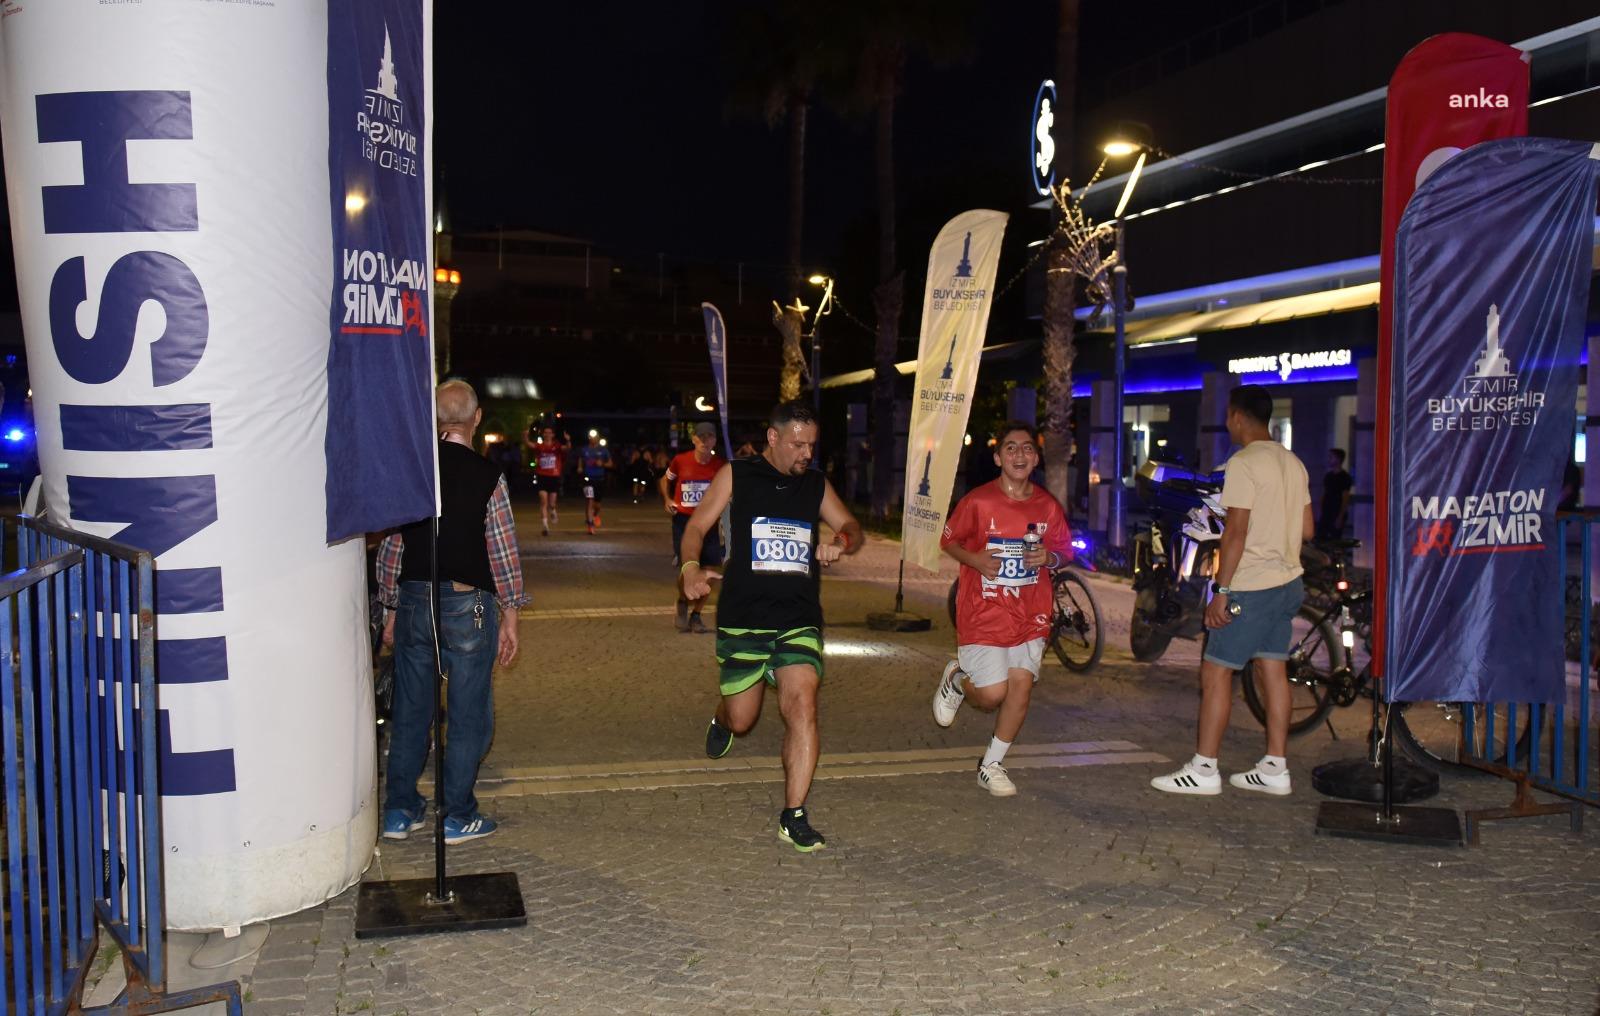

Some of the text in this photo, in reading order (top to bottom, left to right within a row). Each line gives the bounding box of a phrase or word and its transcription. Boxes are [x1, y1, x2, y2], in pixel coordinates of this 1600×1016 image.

[36, 91, 237, 797] FINISH
[1411, 488, 1546, 520] MARATON
[756, 539, 809, 563] 0802
